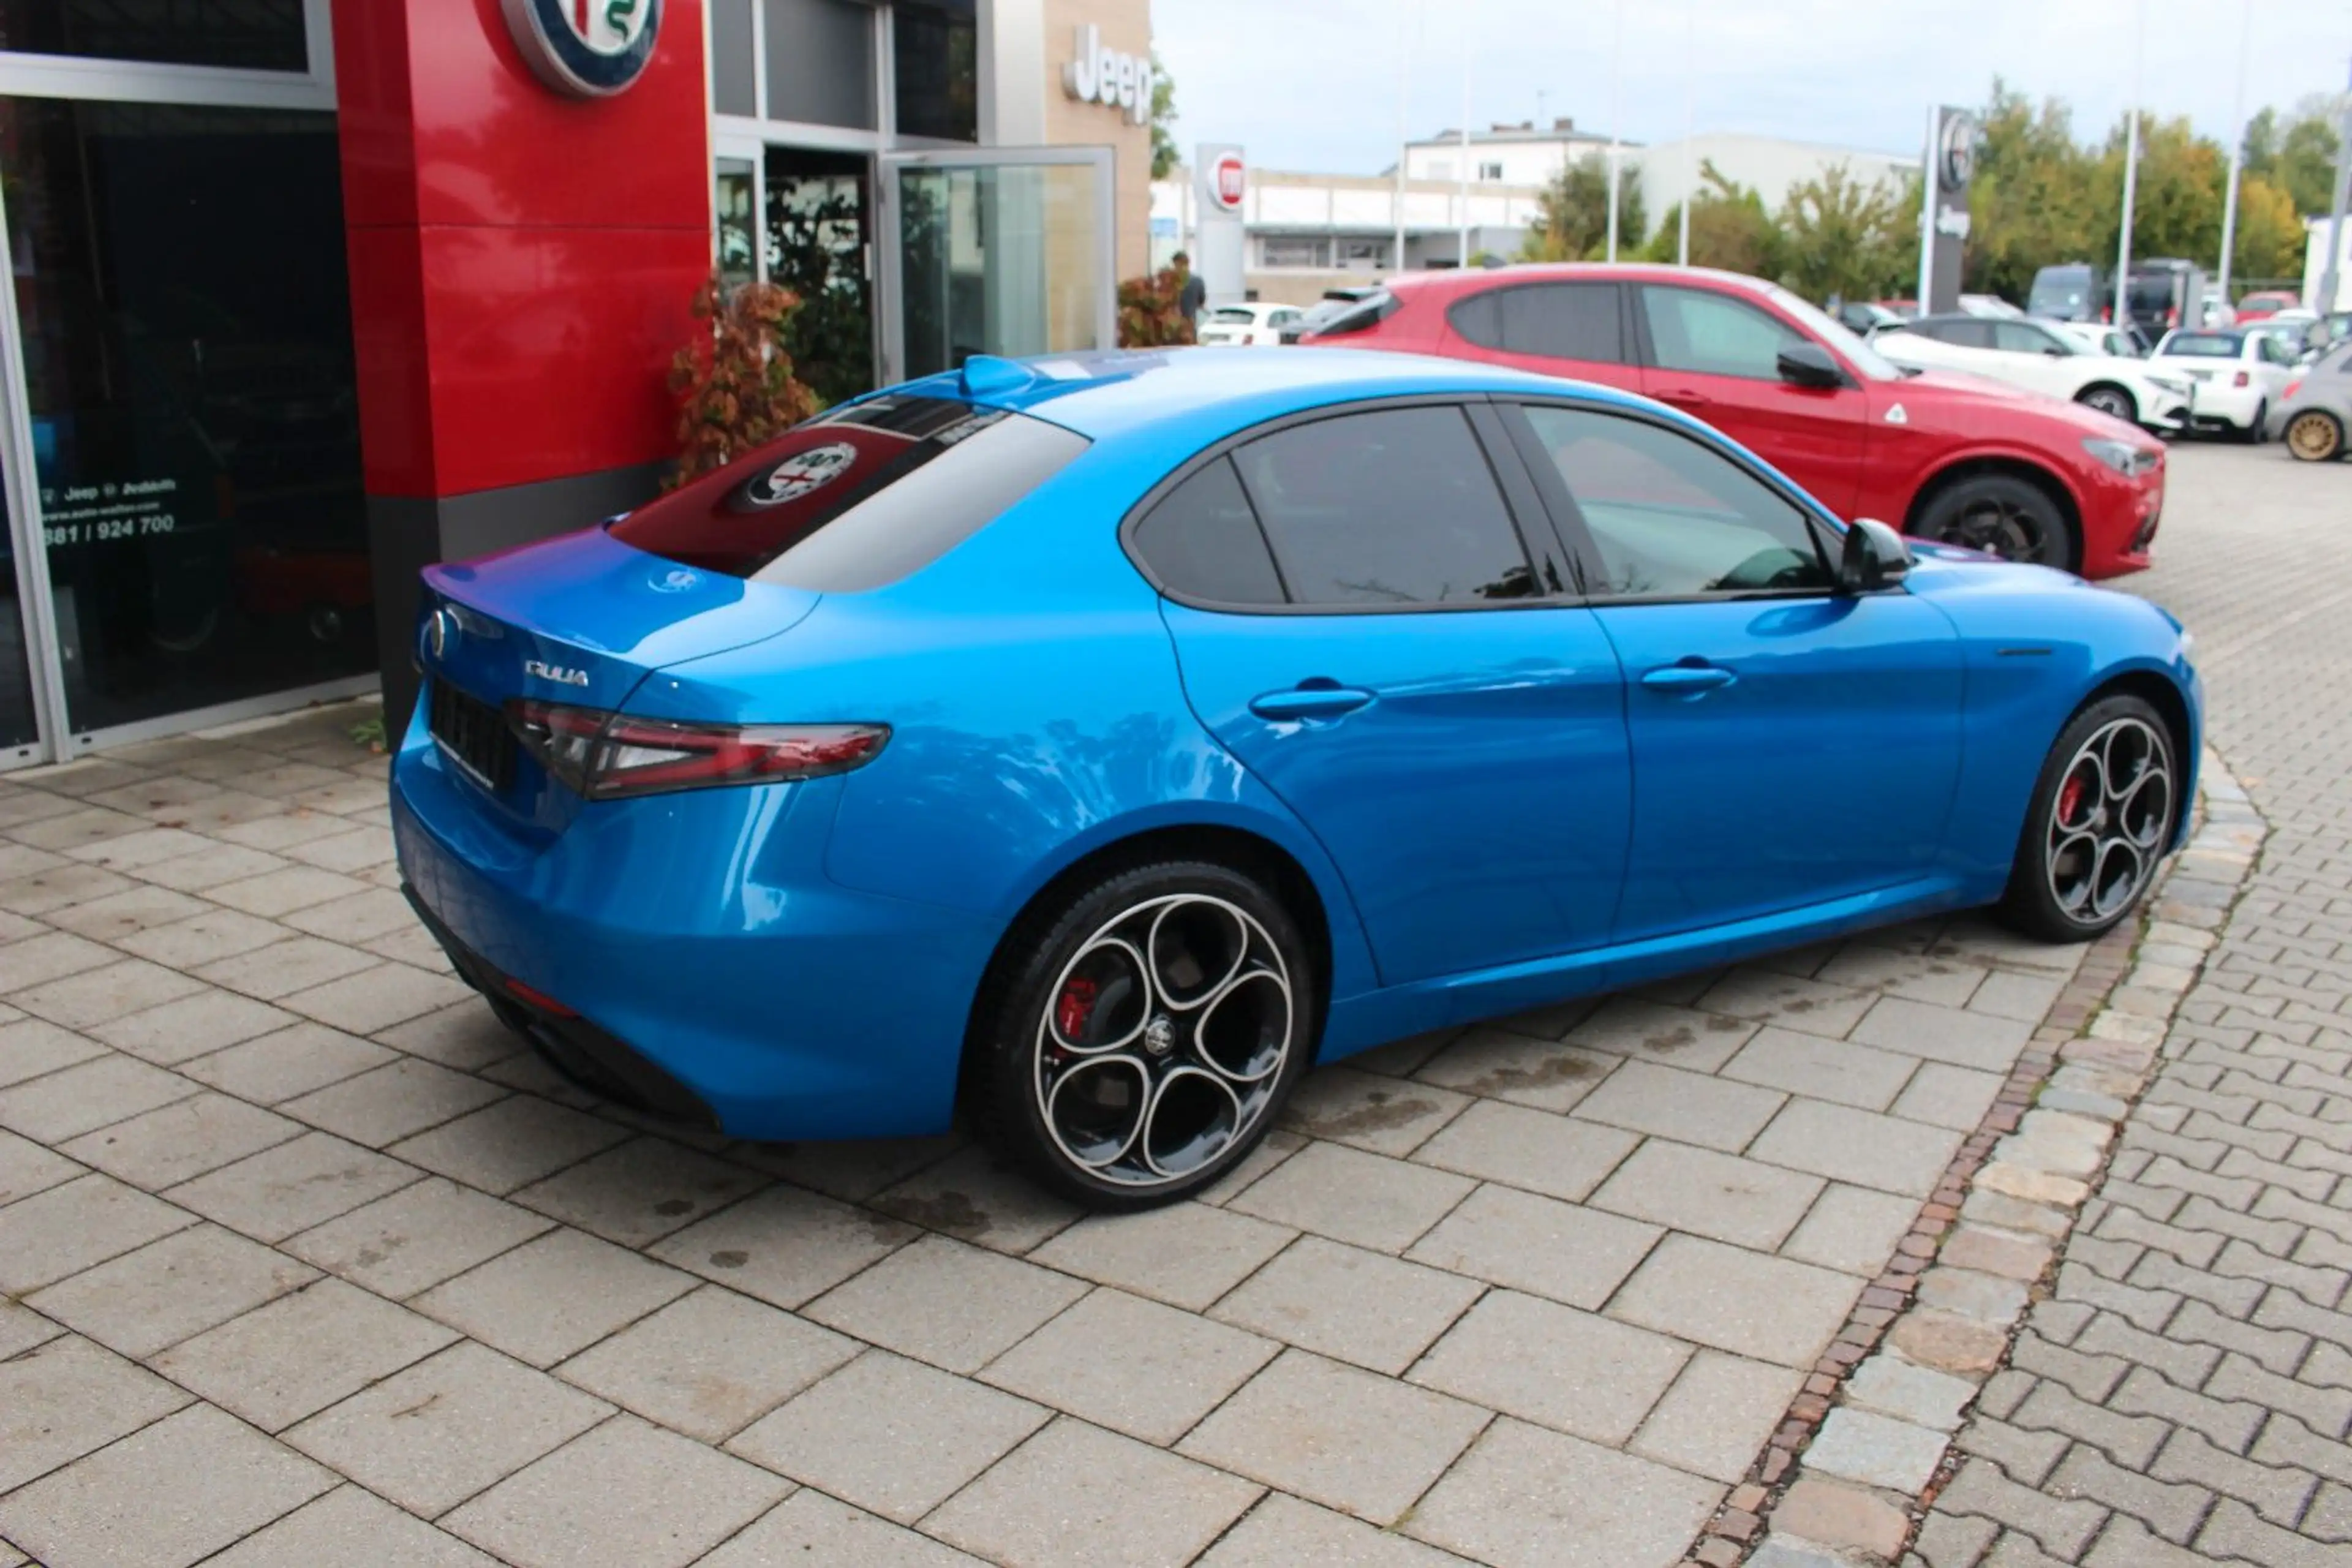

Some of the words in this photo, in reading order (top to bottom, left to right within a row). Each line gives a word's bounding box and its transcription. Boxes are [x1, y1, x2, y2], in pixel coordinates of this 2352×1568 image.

[1069, 24, 1152, 125] Jeep
[64, 486, 99, 502] Jeep
[96, 519, 134, 540] 924
[139, 514, 175, 535] 700
